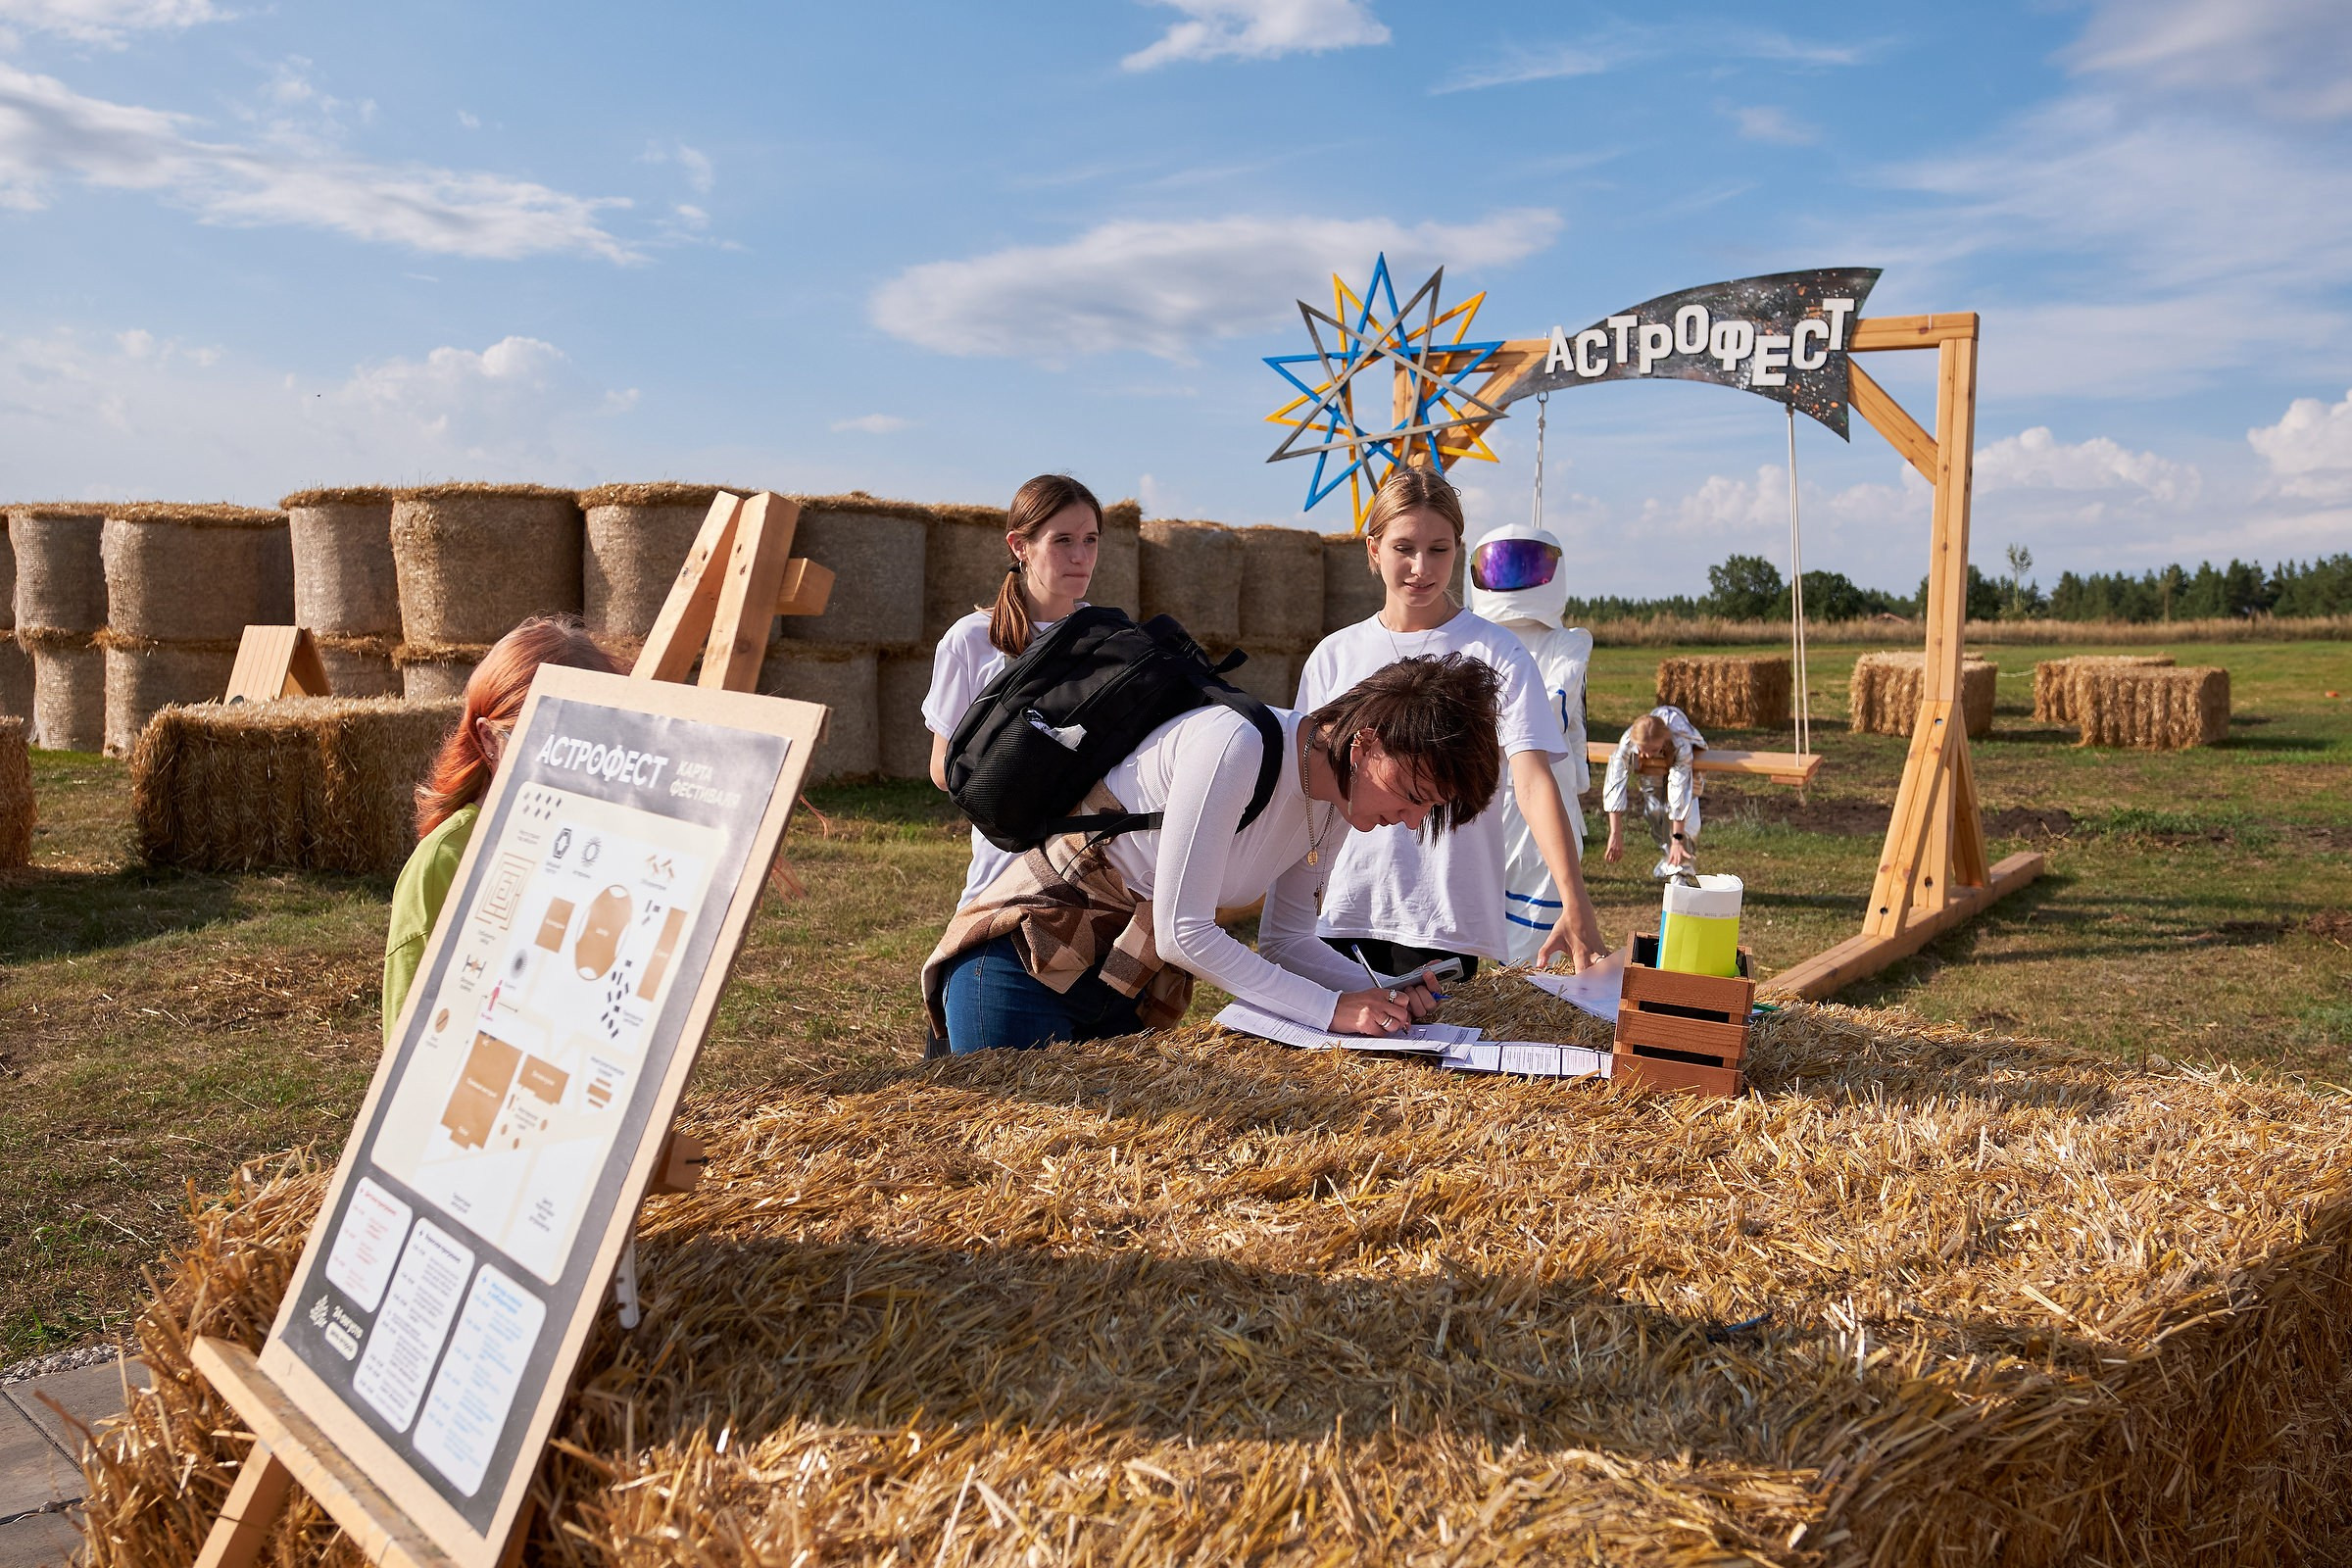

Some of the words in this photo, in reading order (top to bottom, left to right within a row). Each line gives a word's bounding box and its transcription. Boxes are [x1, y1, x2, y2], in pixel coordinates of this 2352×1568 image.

[1544, 298, 1855, 387] АСТРОФЕСТ
[536, 734, 669, 789] АСТРОФЕСТ
[676, 760, 714, 782] КАРТА
[669, 781, 742, 808] ФЕСТИВАЛЯ
